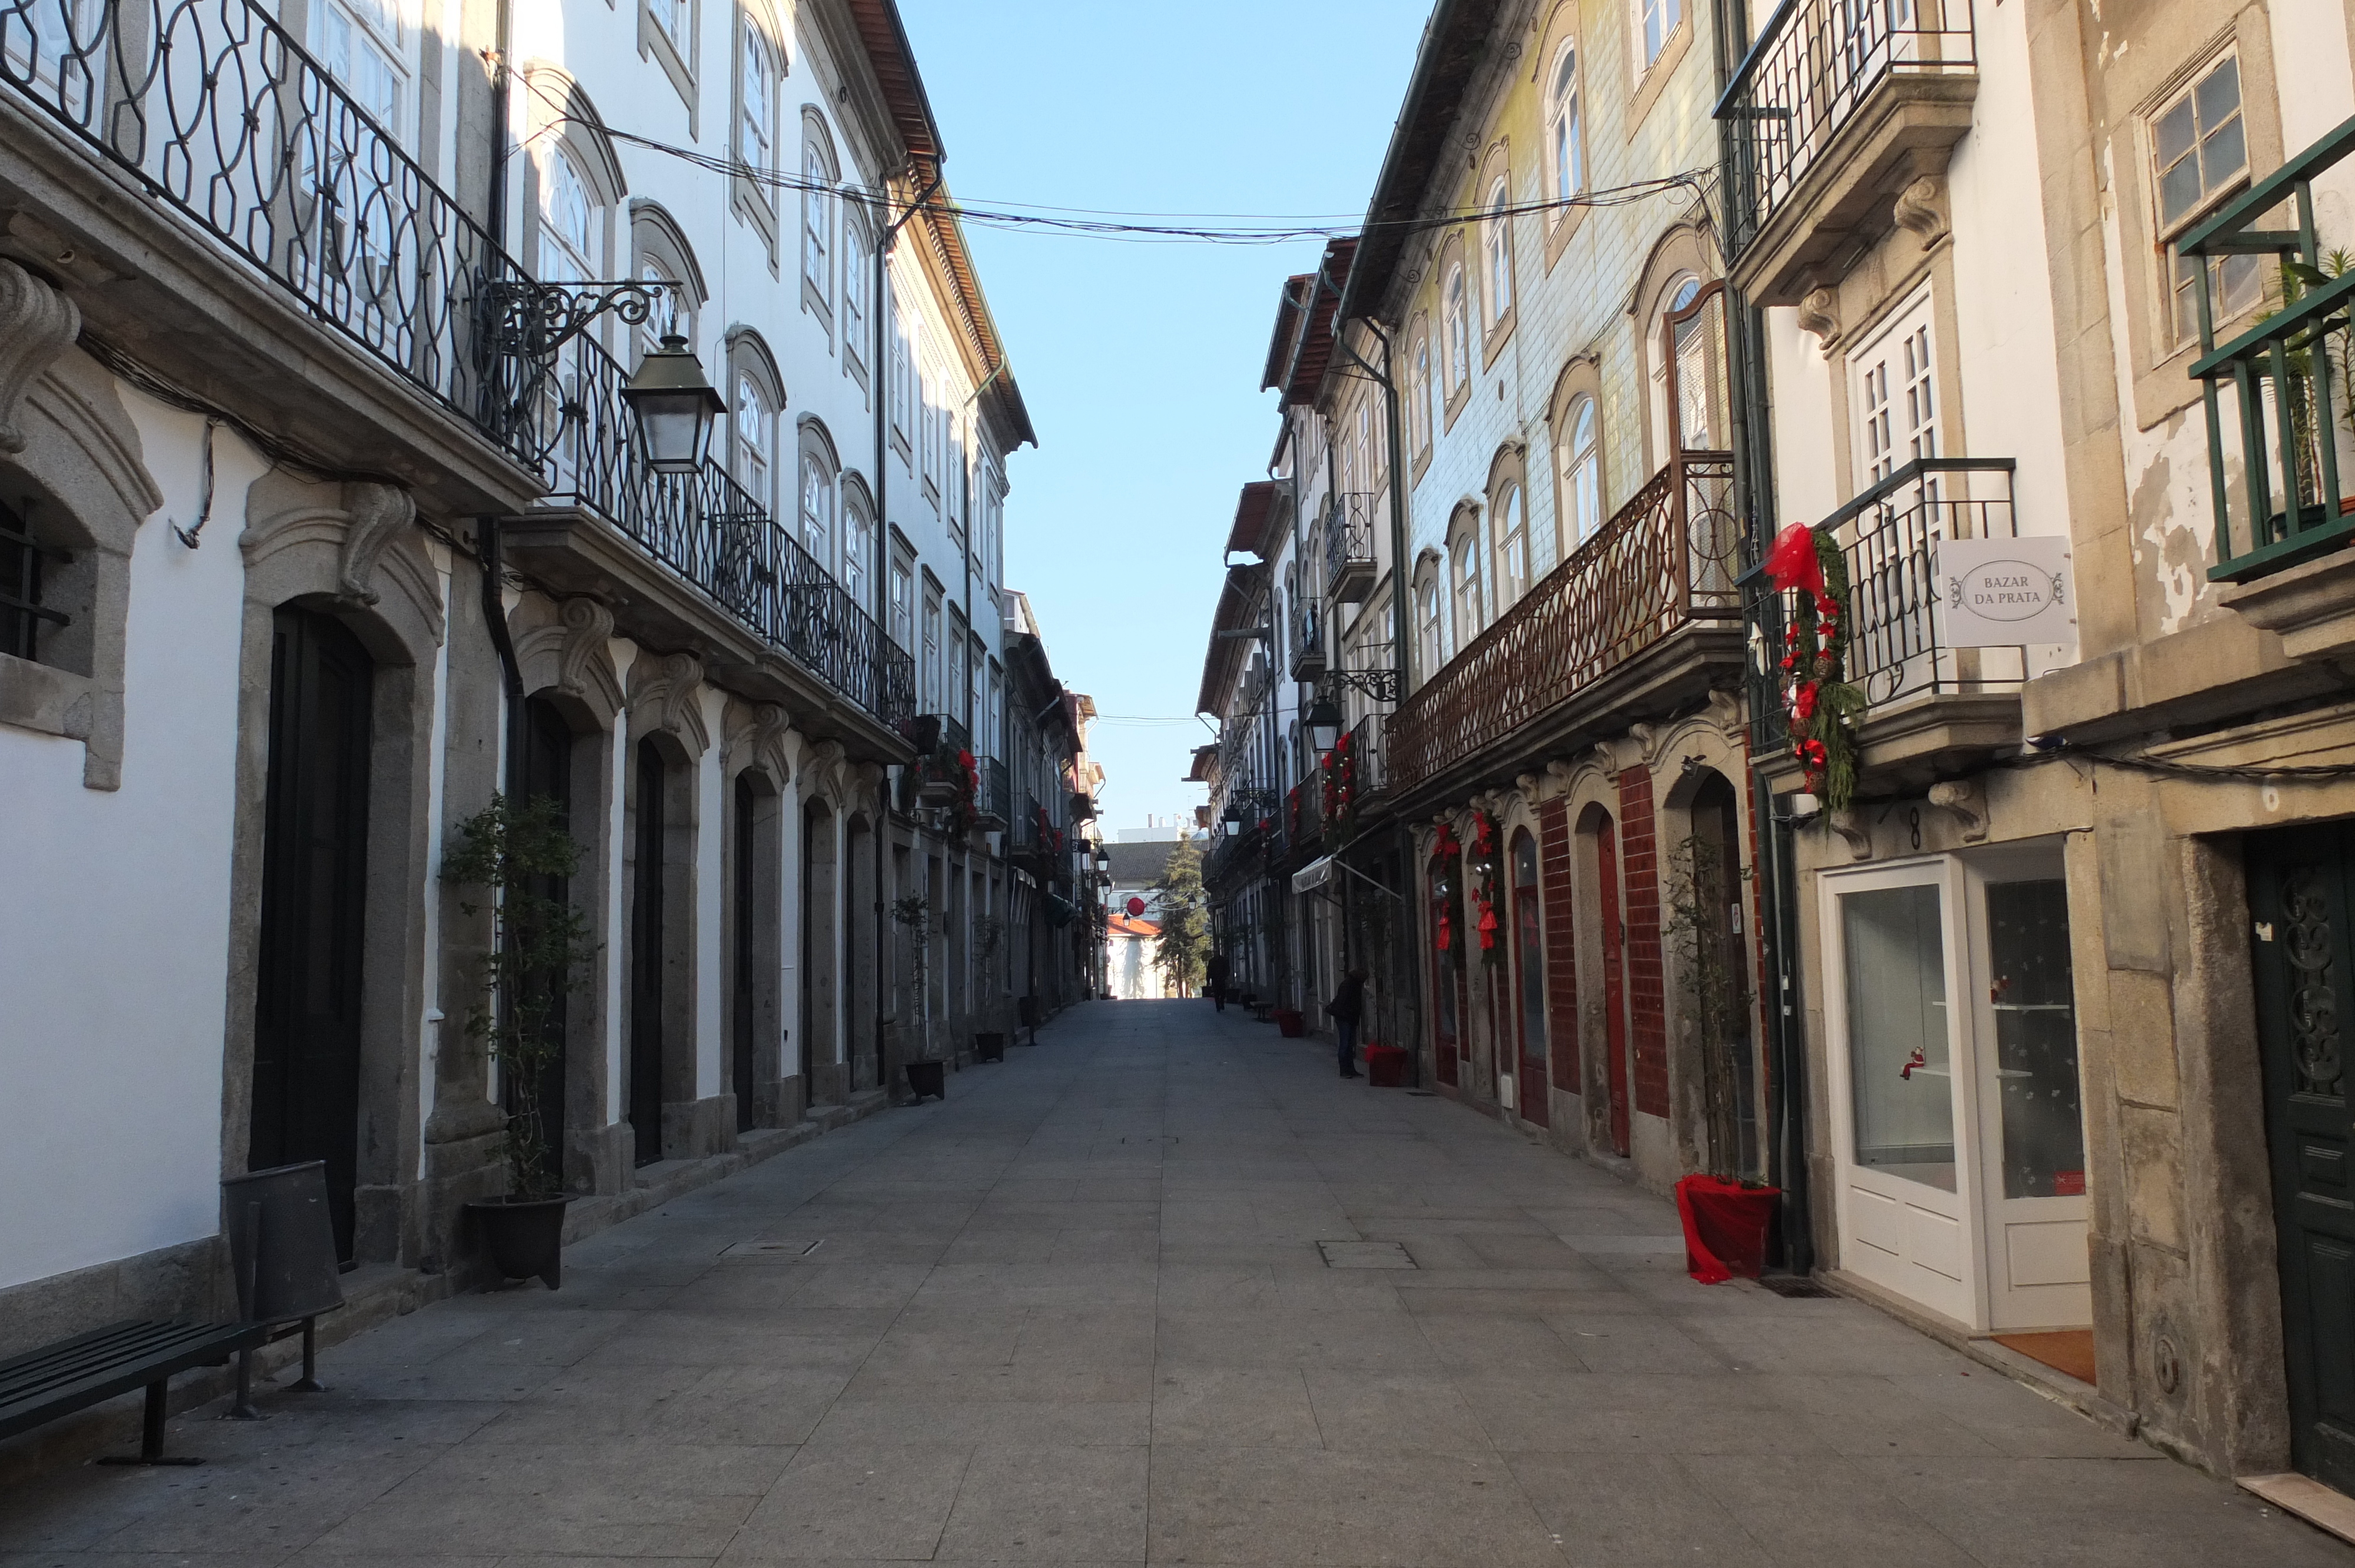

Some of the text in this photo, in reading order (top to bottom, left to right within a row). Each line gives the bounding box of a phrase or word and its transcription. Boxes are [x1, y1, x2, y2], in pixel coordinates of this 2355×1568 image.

[1984, 576, 2028, 588] BAZAR
[1975, 592, 2041, 604] DA PRATA
